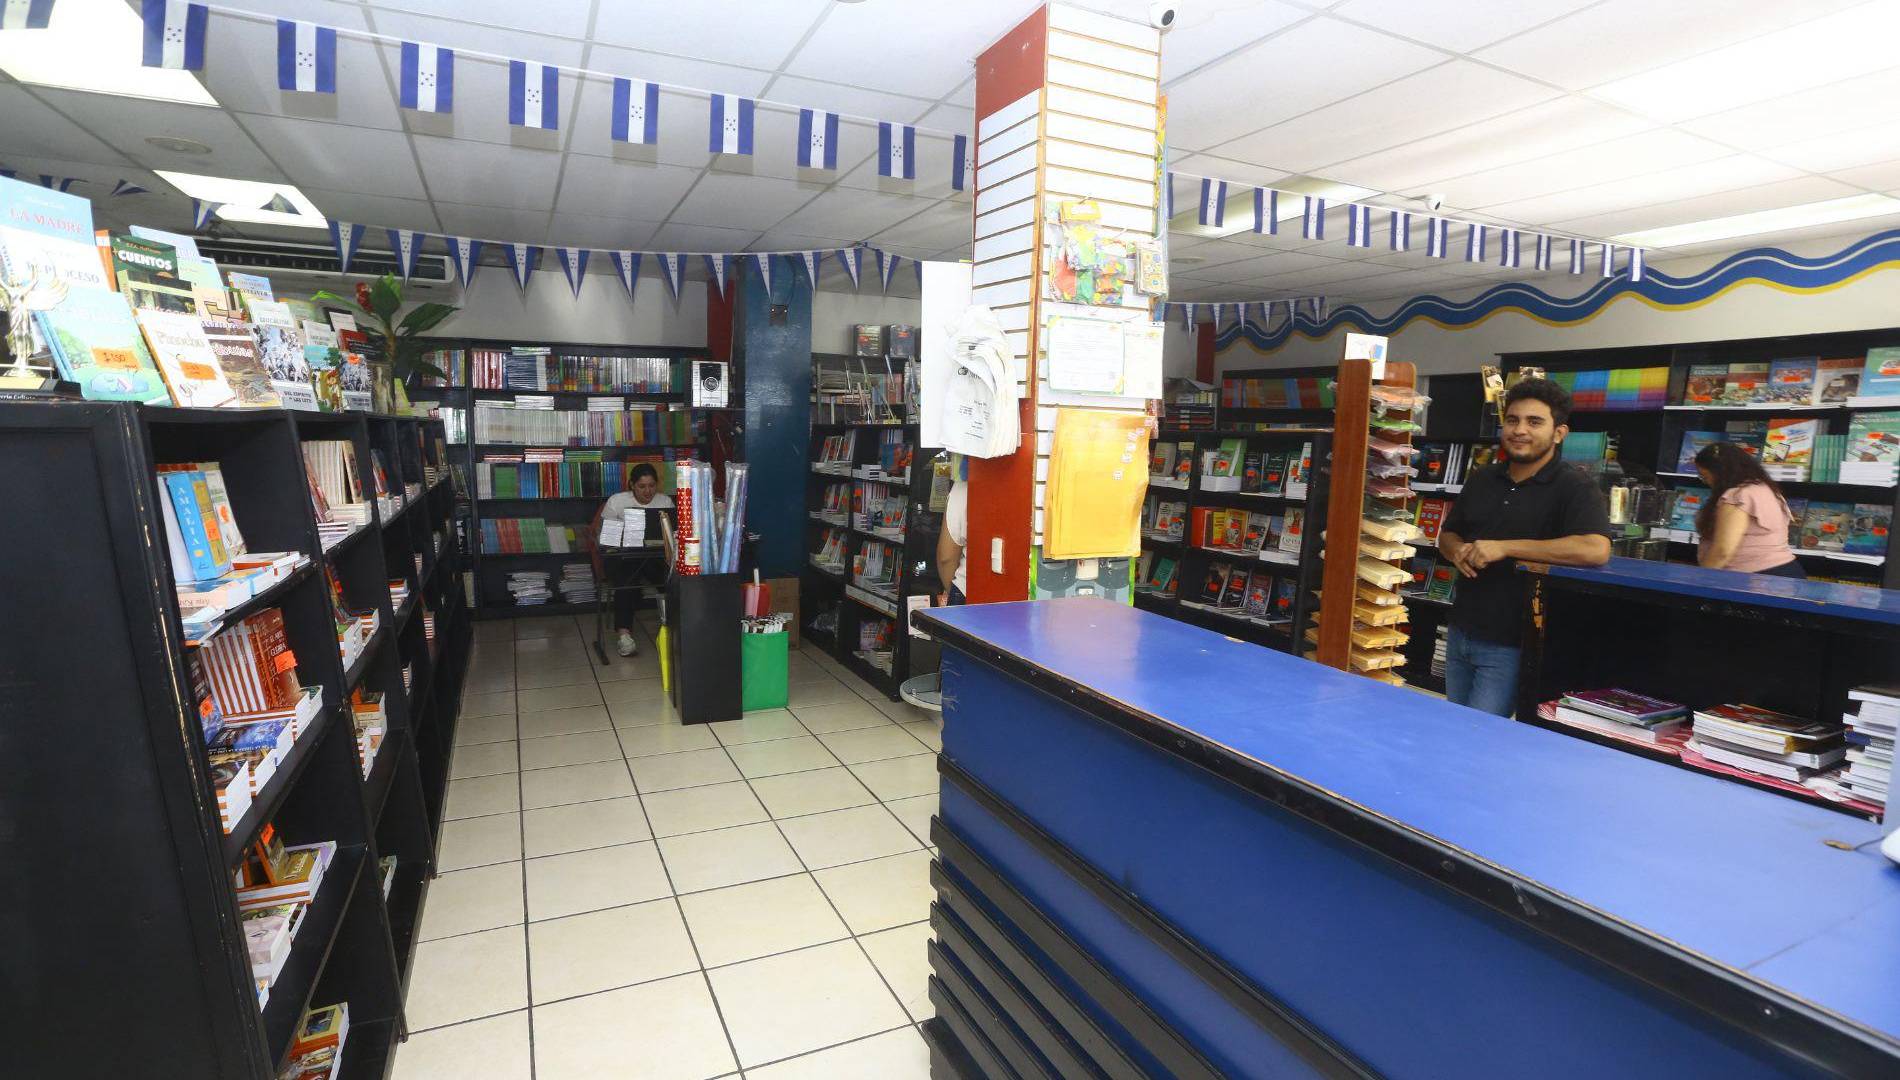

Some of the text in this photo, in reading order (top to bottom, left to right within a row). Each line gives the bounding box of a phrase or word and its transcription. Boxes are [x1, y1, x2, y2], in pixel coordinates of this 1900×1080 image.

[117, 249, 173, 271] CUENTOS
[44, 264, 101, 285] PCESO
[178, 487, 200, 546] AMALIA
